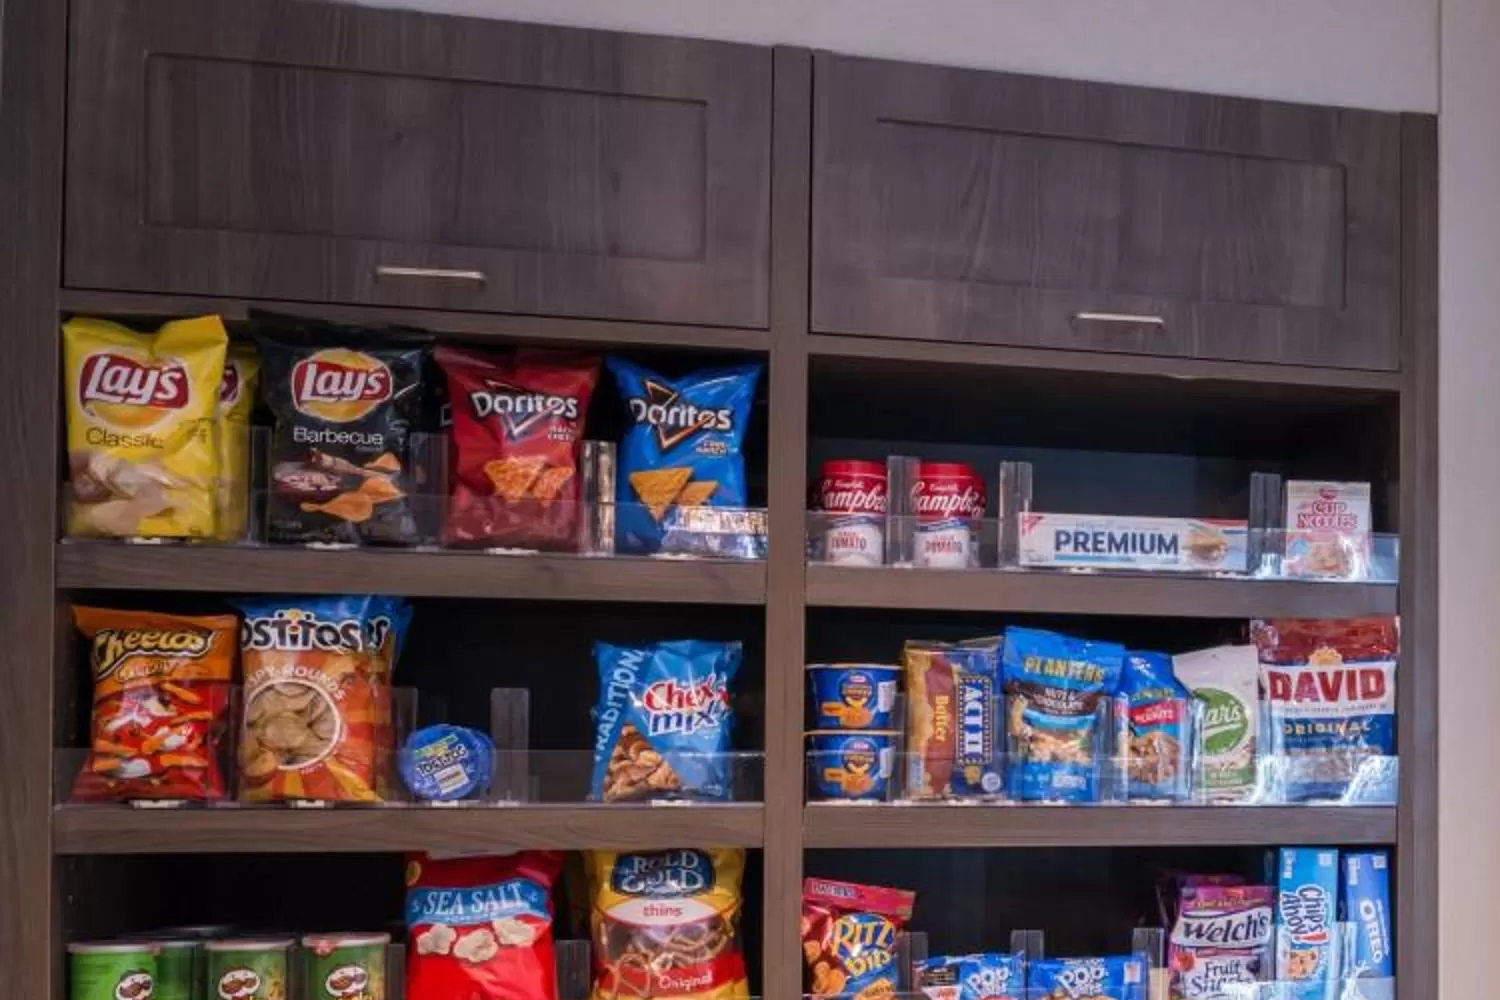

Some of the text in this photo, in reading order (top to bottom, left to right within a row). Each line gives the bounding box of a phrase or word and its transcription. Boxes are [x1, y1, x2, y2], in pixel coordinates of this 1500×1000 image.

[85, 357, 182, 409] Lay's
[302, 361, 386, 402] Lay's
[471, 390, 578, 419] Doritos
[629, 399, 733, 430] Doritos
[86, 427, 164, 449] Classic
[293, 427, 384, 446] Barbecue
[1054, 529, 1179, 556] PREMIUM
[1023, 656, 1106, 683] PLANTERS
[1268, 668, 1386, 703] DAVID
[935, 694, 950, 743] Butter
[423, 882, 523, 917] SEA SALT
[643, 902, 683, 917] thins
[1300, 886, 1325, 933] Chips
[831, 916, 895, 958] RITZ
[1183, 911, 1269, 945] Welch's
[1361, 901, 1384, 963] OREO
[659, 968, 712, 992] Original
[1206, 959, 1242, 977] Fruit
